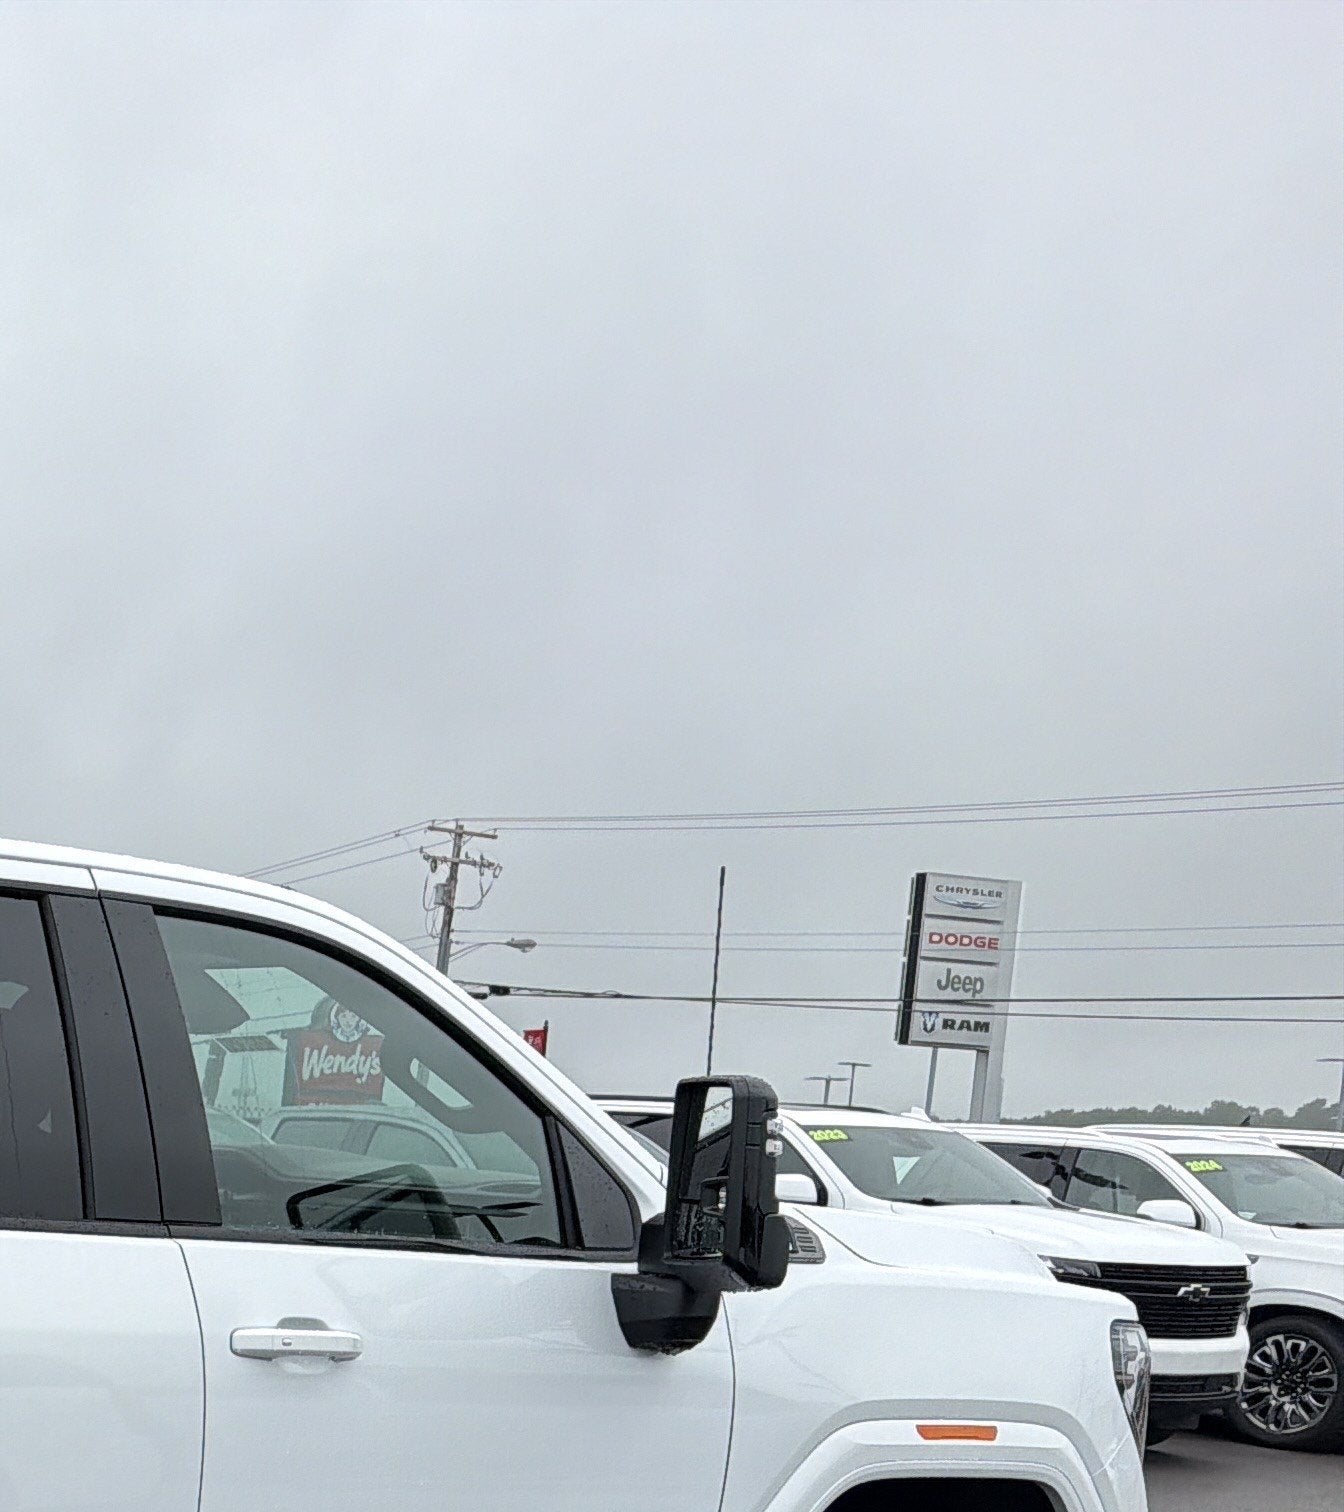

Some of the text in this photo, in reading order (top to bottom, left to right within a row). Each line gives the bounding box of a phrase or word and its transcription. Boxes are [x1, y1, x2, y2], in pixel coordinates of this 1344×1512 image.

[934, 884, 1004, 899] CHRYSLER
[928, 931, 1000, 951] DODGE
[936, 967, 985, 998] Jeep
[941, 1016, 991, 1034] RAM
[301, 1045, 381, 1084] Wendy's
